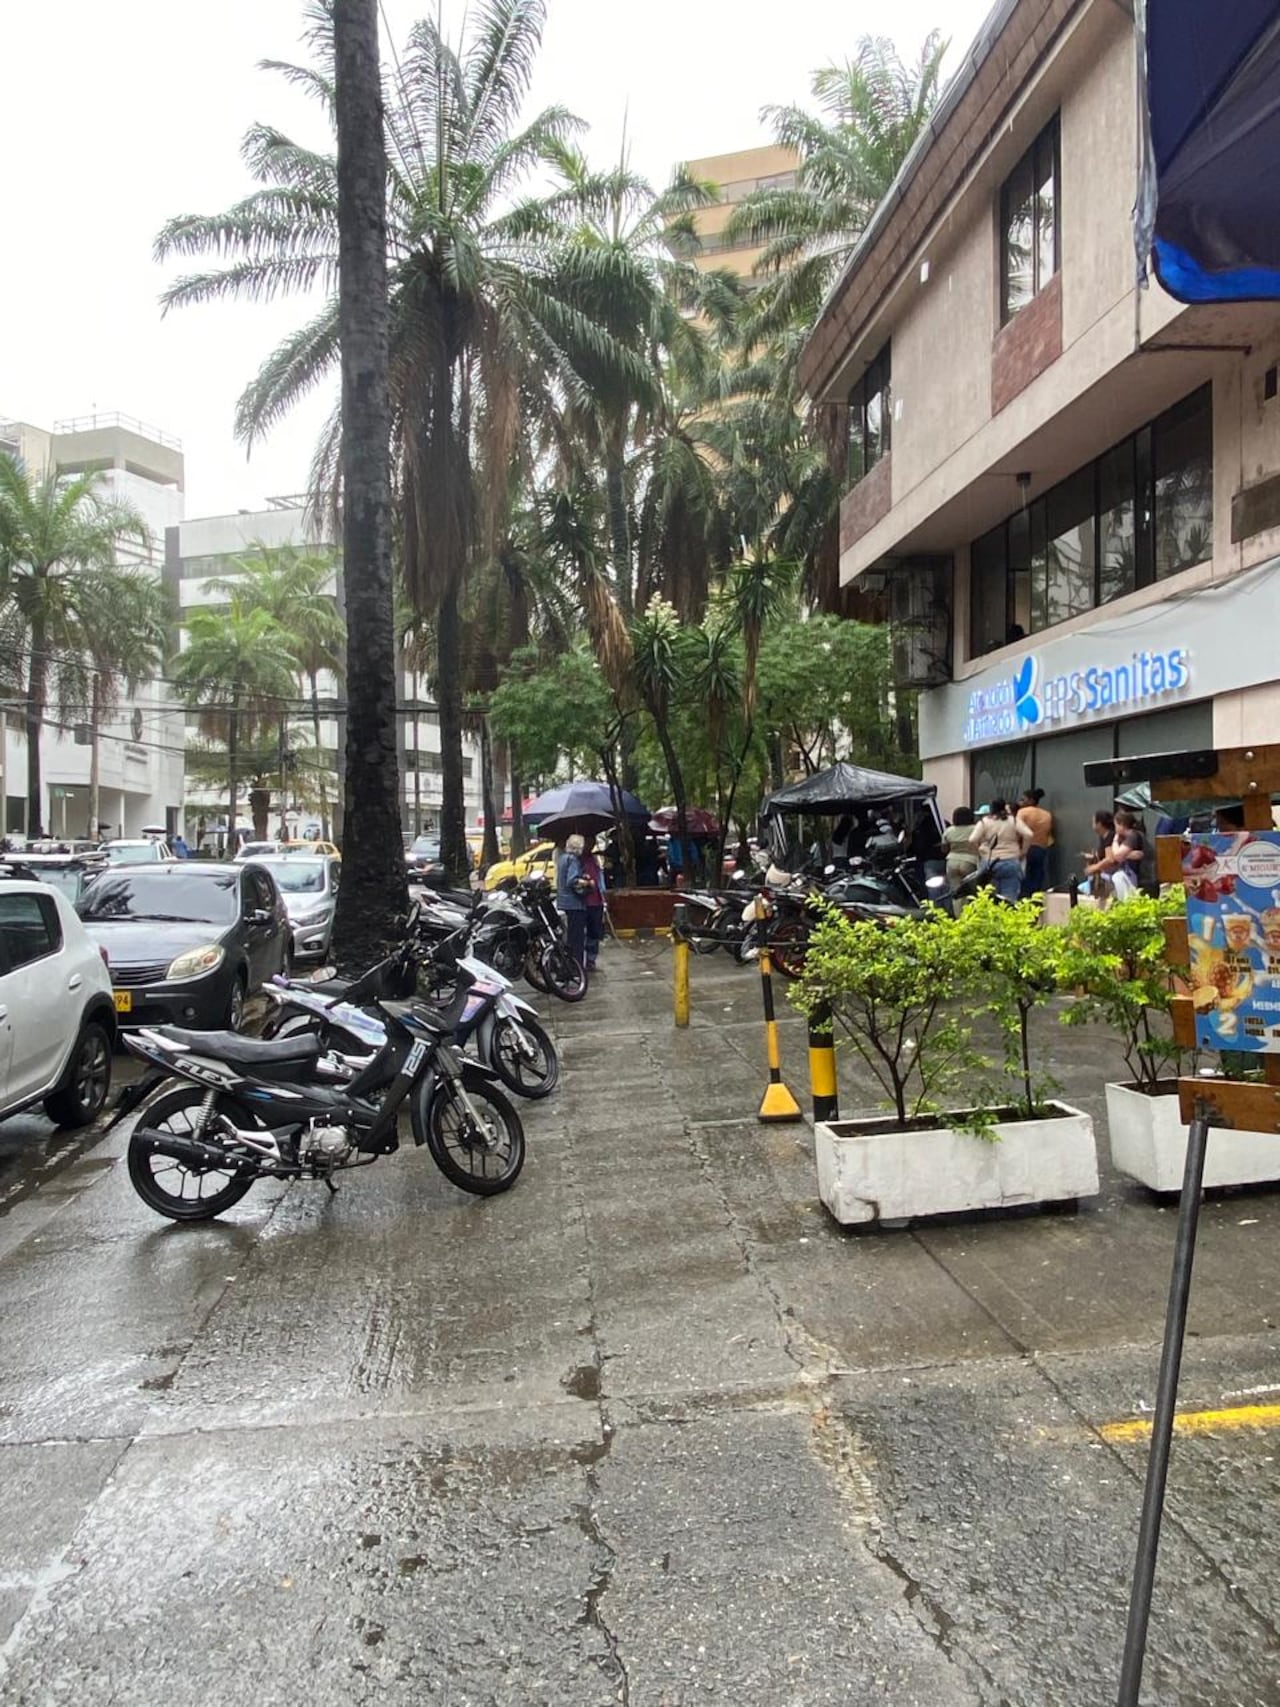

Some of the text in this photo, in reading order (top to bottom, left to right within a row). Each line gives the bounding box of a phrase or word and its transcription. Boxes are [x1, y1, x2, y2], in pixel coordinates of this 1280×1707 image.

[1084, 649, 1190, 711] Sanitas
[1217, 1013, 1237, 1036] 2
[174, 1059, 244, 1090] FLEX
